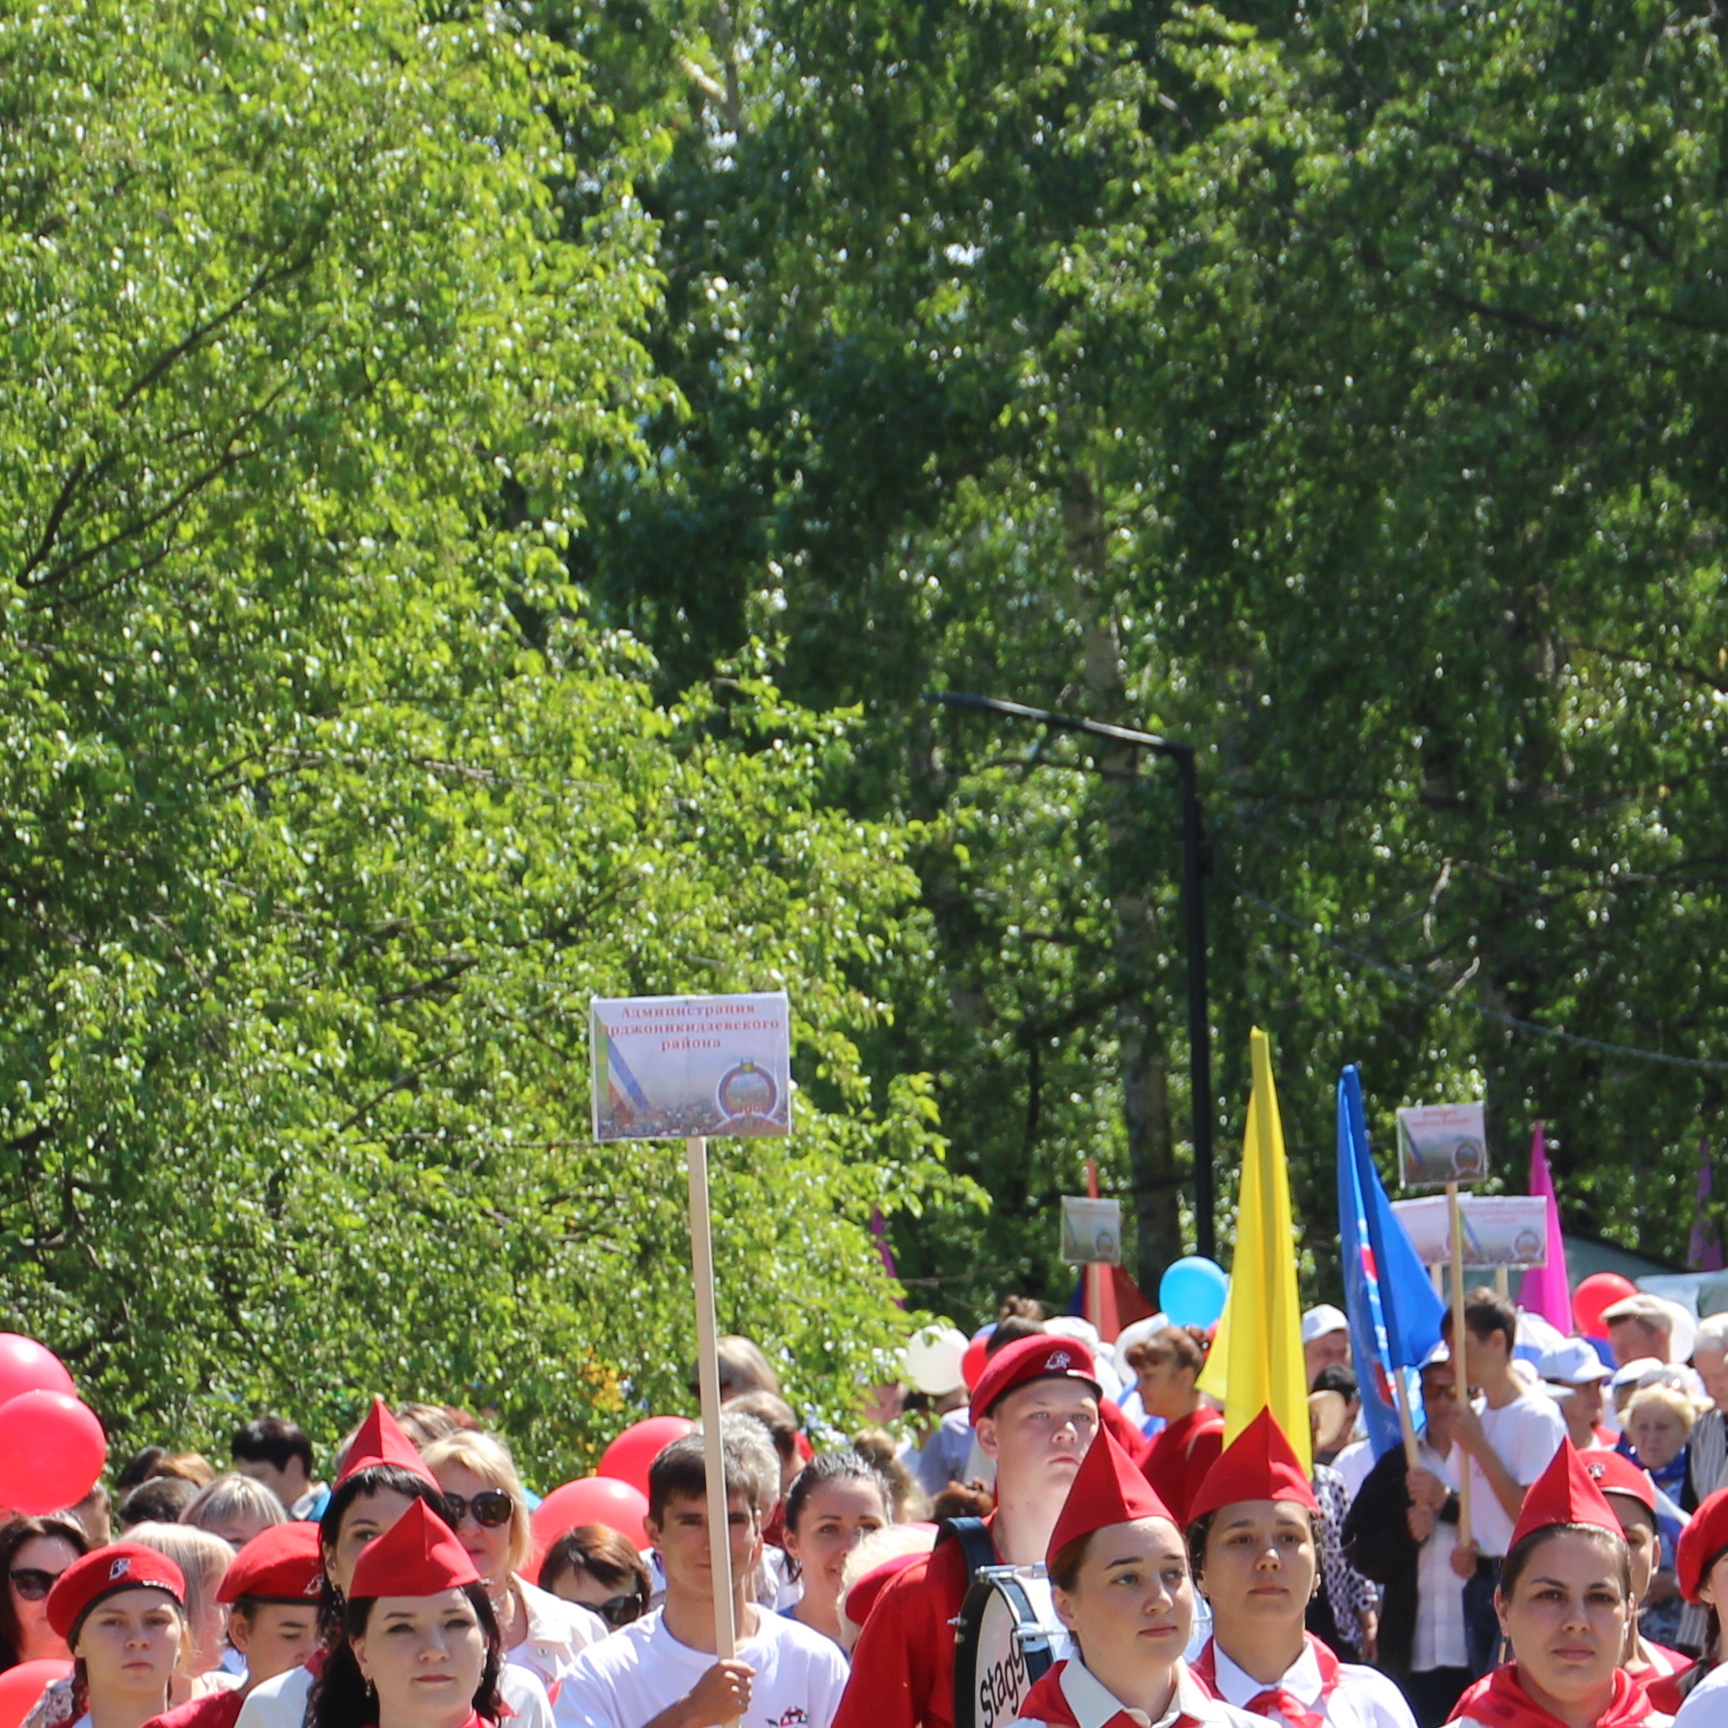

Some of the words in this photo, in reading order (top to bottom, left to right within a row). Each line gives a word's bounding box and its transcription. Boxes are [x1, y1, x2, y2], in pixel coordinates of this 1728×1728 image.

[622, 1003, 756, 1020] Администрация
[597, 1020, 779, 1038] Орджоникидзевского
[661, 1036, 722, 1052] района
